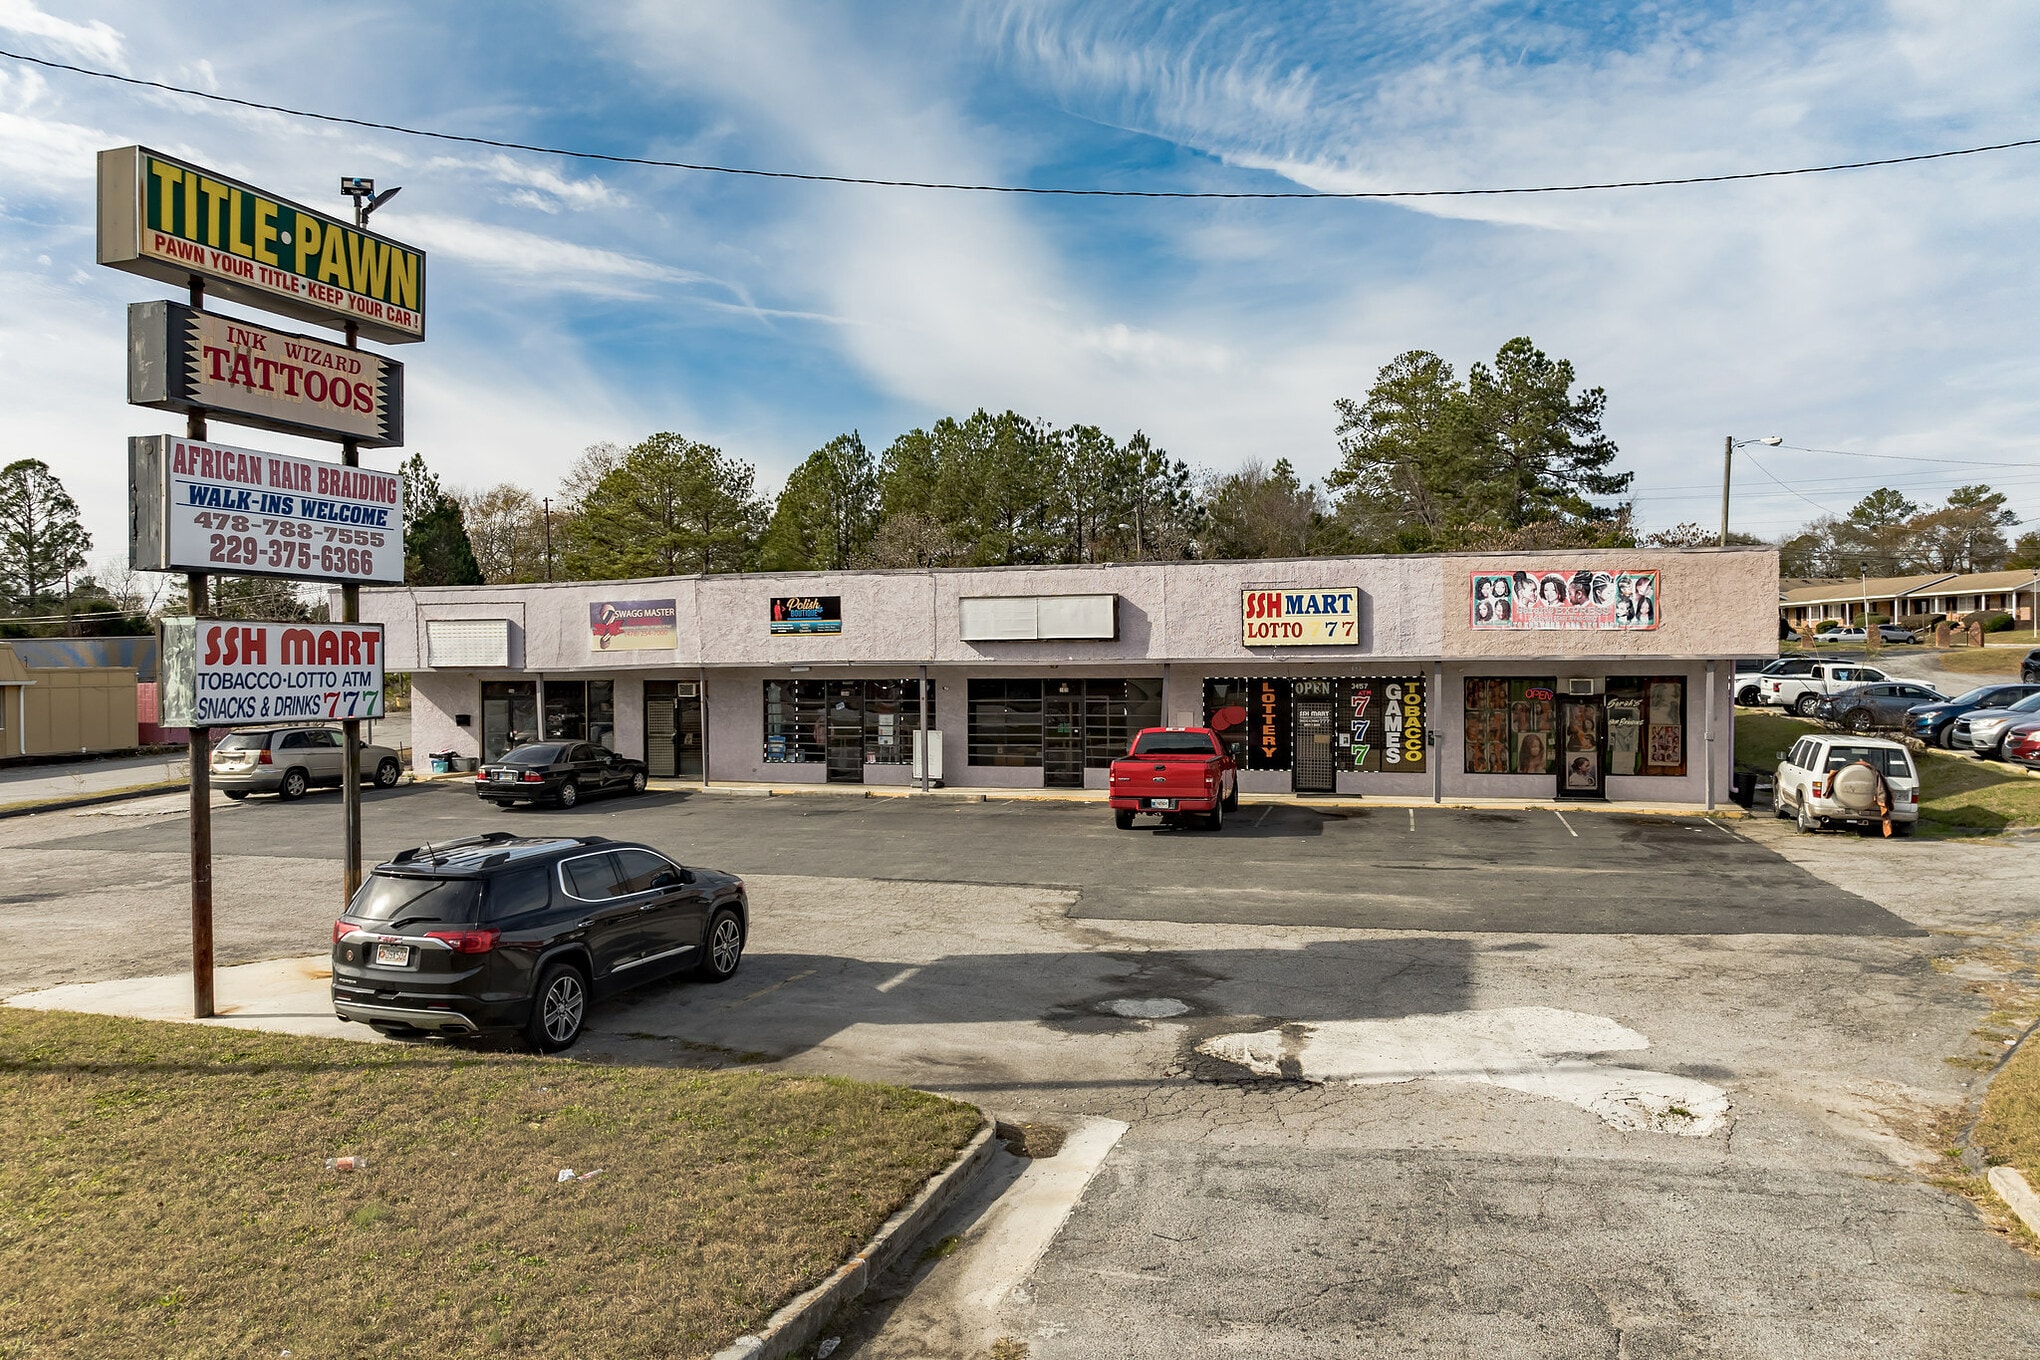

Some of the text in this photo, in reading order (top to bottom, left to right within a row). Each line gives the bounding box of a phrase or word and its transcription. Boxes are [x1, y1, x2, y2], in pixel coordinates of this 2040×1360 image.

[152, 159, 417, 310] TITLE PAWN
[155, 233, 205, 265] PAWN
[210, 253, 254, 280] YOUR
[259, 266, 299, 293] TITLE
[307, 282, 344, 305] KEEP
[349, 296, 383, 320] YOUR
[226, 325, 361, 375] INK WIZARD
[203, 345, 374, 414] TATTOOS
[172, 443, 397, 504] AFRICAN HAIR BRAIDING
[189, 484, 388, 527] WALK-INS WELCOME
[193, 511, 385, 548] 478-788-7555
[209, 533, 374, 576] 229-375-6366
[614, 608, 675, 618] SWAGG MASTER
[786, 597, 820, 611] Polish
[790, 609, 819, 617] BOUTIQUE
[1246, 592, 1353, 619] SSH MART
[1554, 606, 1611, 616] EXPRESS
[204, 626, 380, 666] SSH MART
[1247, 622, 1303, 639] LOTTO
[198, 671, 372, 690] TOBACCO LOTTO ATM
[1295, 681, 1331, 695] OPEN
[1525, 689, 1553, 701] OPEN
[198, 696, 257, 720] SNACKS
[260, 698, 270, 717] &
[274, 695, 321, 717] DRINKS
[1261, 682, 1277, 758] LOTTERY
[1384, 683, 1402, 764] GAMES
[1403, 682, 1423, 762] TOBACCO
